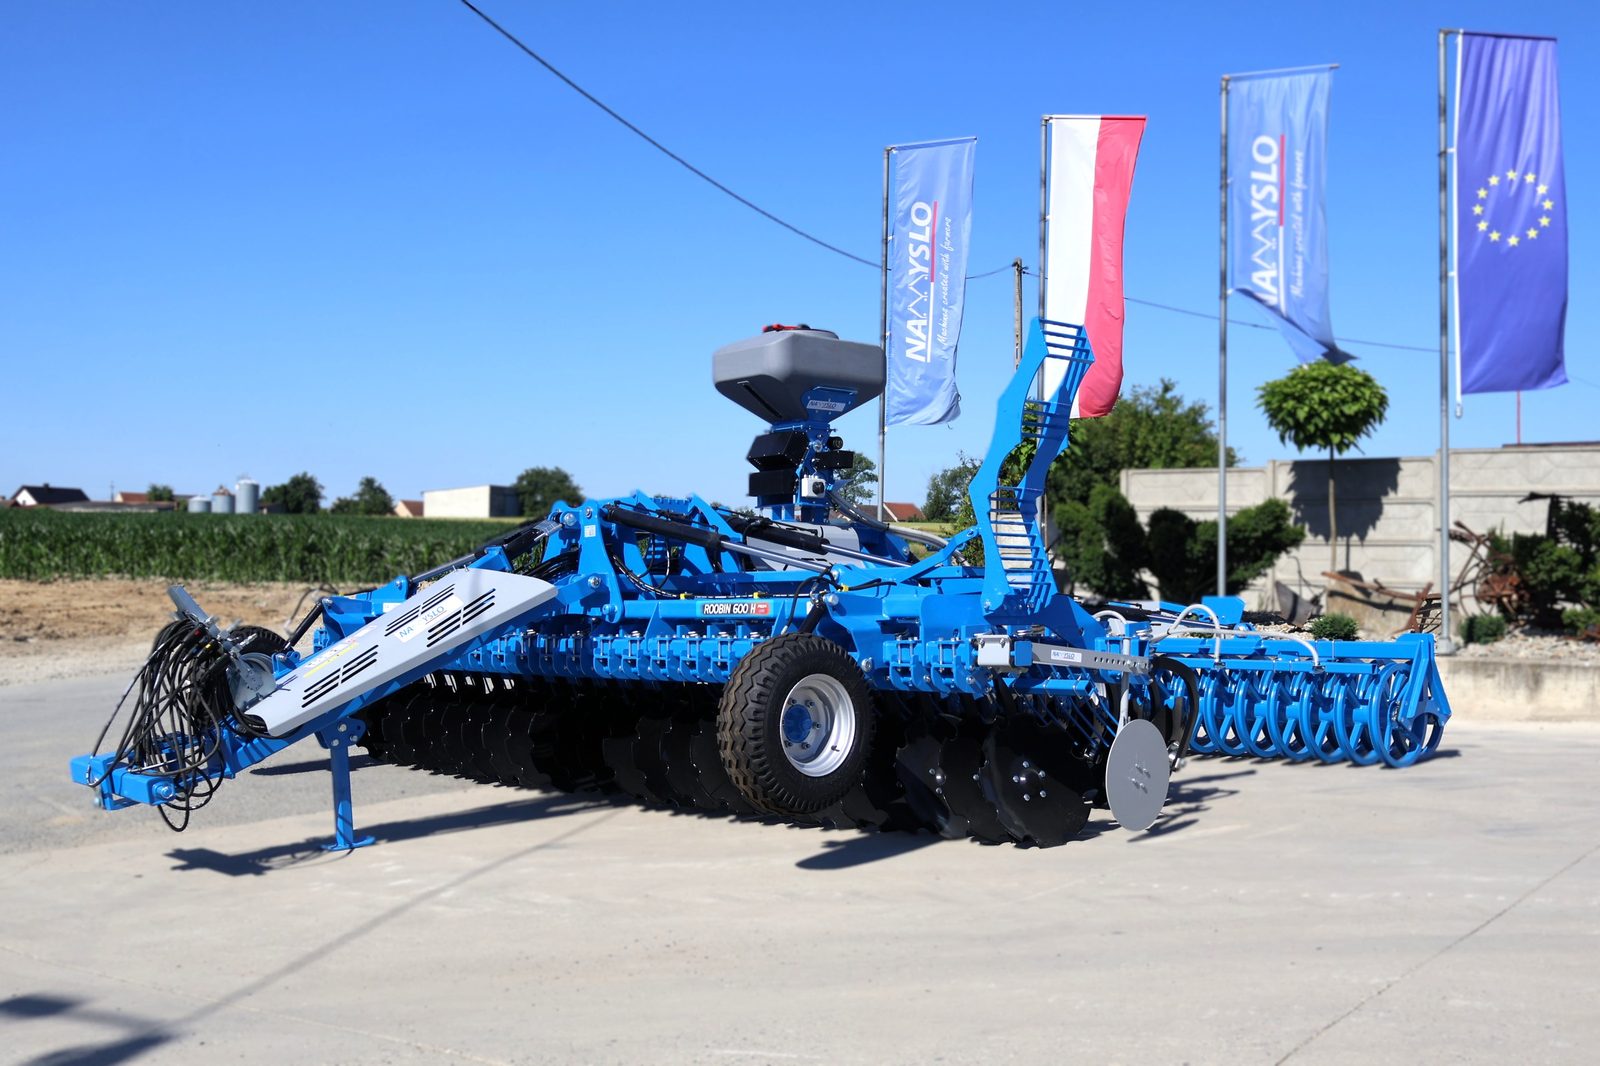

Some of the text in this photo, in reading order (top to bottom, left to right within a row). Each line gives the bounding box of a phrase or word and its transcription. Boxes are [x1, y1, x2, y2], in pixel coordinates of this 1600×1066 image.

[936, 216, 955, 346] Machines created with farmers
[703, 603, 732, 615] ROOBIN
[732, 603, 749, 614] 600
[750, 603, 757, 614] H
